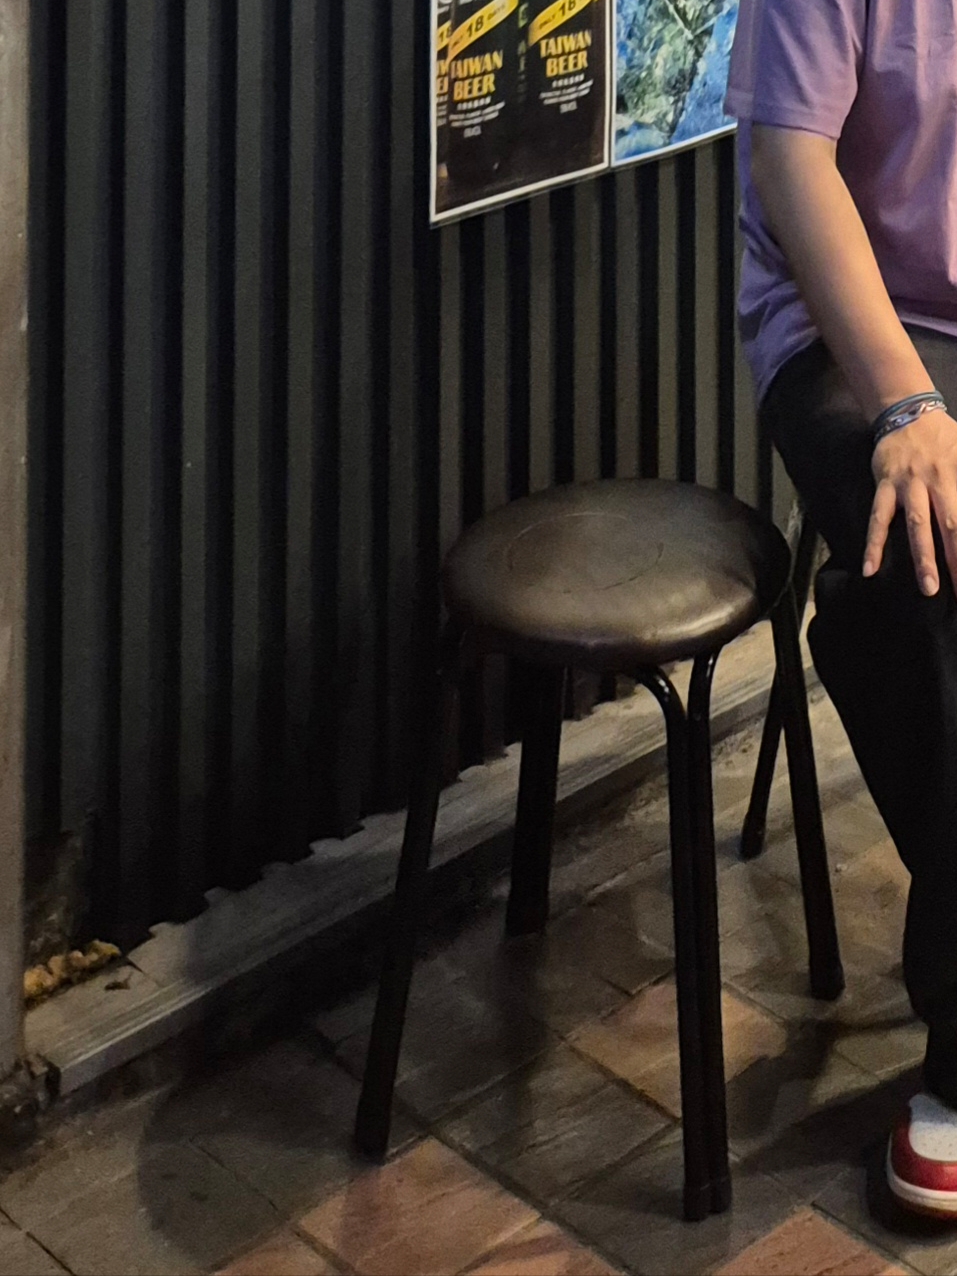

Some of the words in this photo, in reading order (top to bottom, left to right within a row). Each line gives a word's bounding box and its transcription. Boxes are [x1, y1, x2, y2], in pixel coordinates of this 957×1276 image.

[466, 14, 484, 38] 18
[540, 29, 593, 59] TAIWAN
[450, 49, 504, 80] TAIWAN
[545, 50, 589, 78] BEER
[453, 72, 497, 103] BEER
